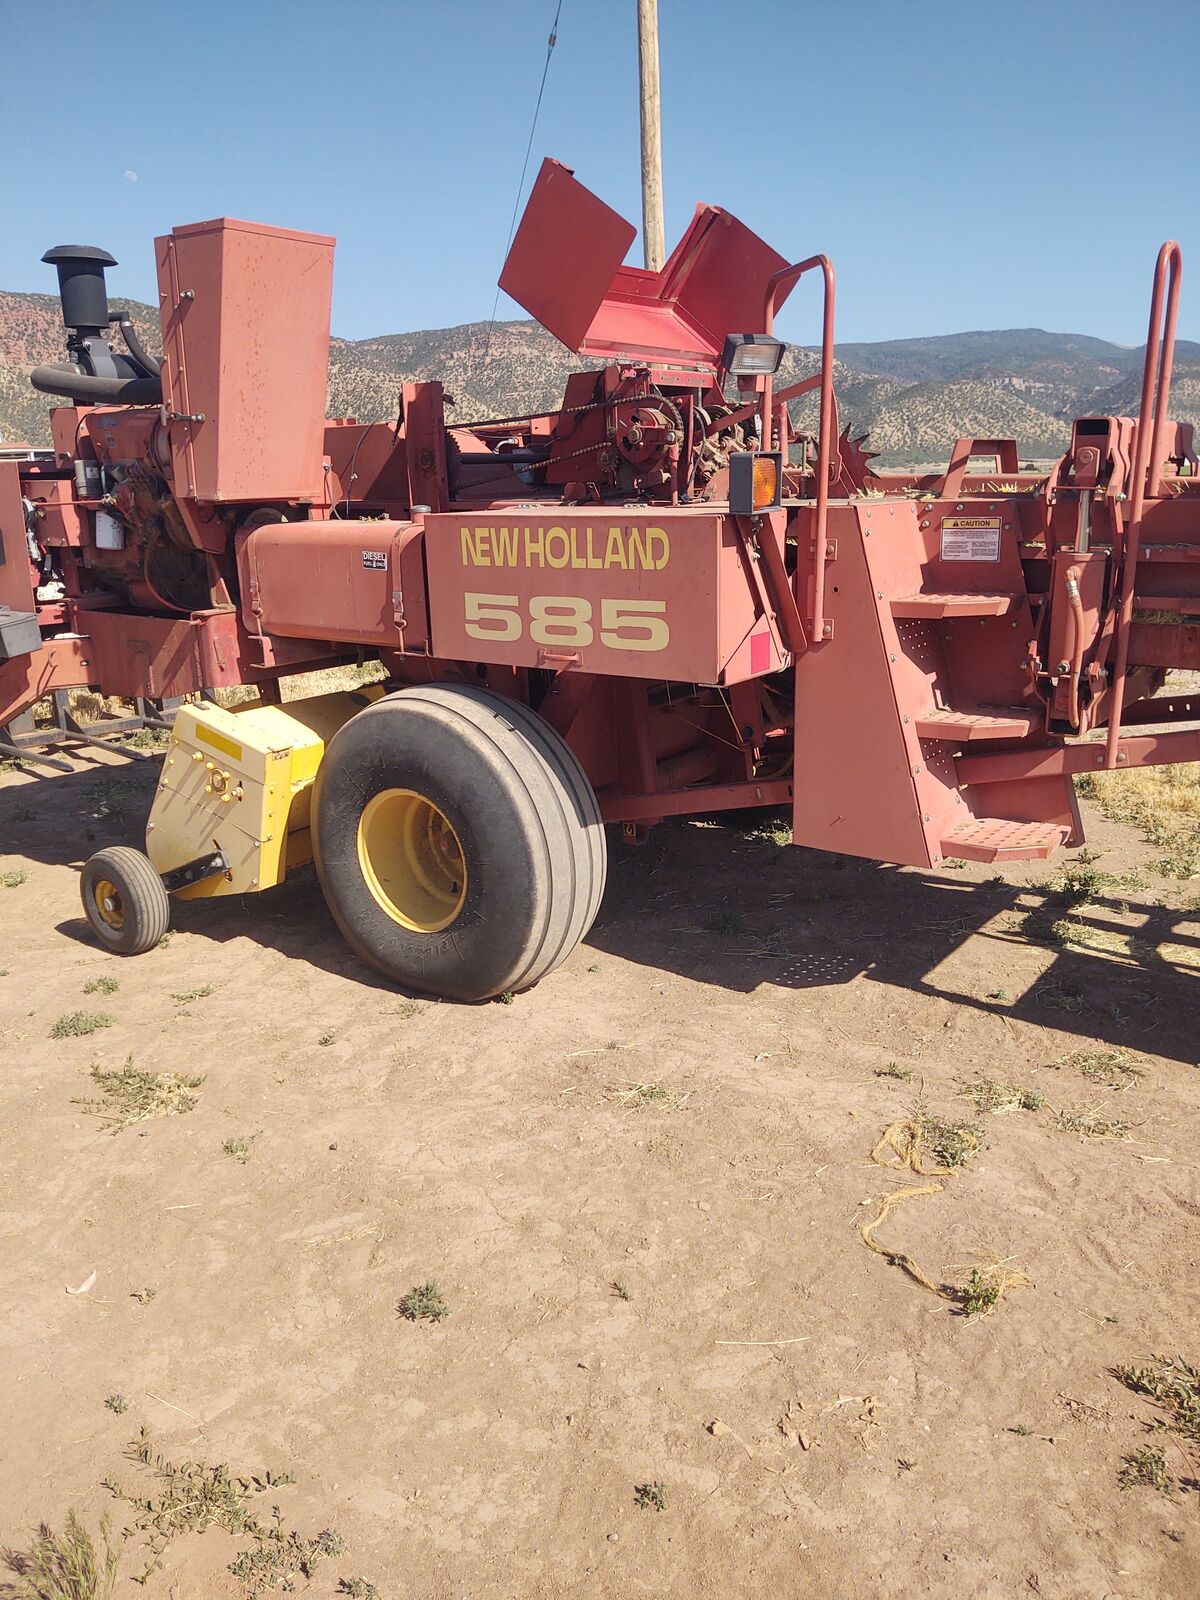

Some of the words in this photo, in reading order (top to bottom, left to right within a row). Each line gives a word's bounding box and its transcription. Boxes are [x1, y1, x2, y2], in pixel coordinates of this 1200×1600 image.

[363, 552, 386, 561] DIESEL
[460, 527, 519, 567] NEW
[524, 526, 670, 570] HOLLAND
[464, 592, 670, 652] 585
